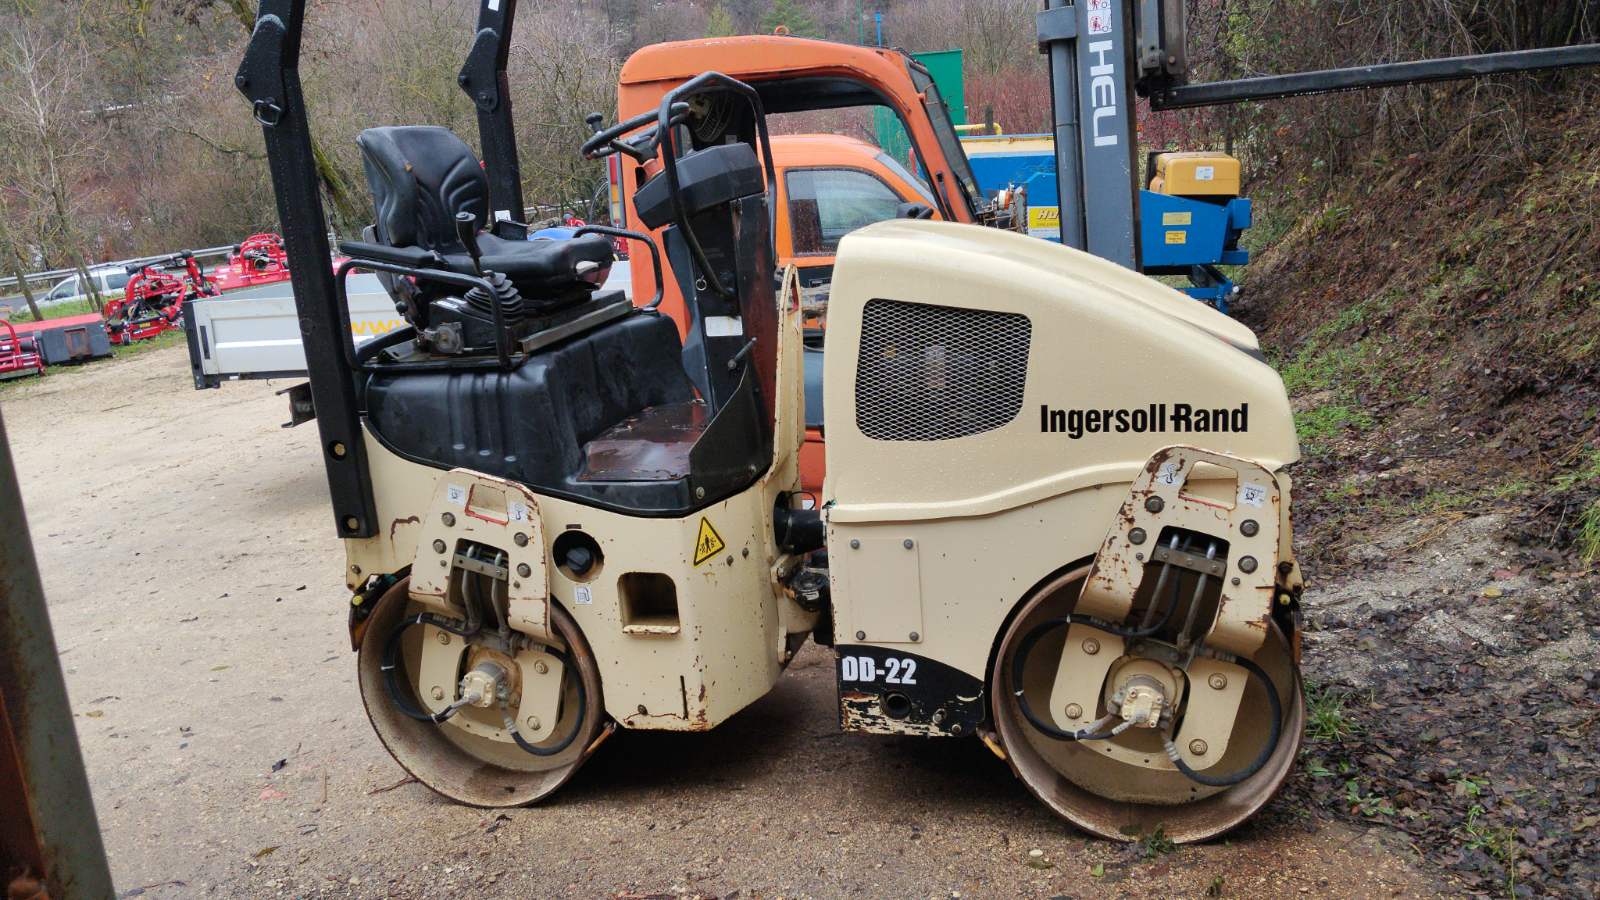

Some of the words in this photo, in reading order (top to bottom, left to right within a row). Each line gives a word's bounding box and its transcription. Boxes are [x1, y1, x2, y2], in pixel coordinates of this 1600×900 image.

[1089, 40, 1118, 147] HELI
[1041, 403, 1249, 439] Ingersoll-Rand
[842, 656, 917, 685] DD-22
